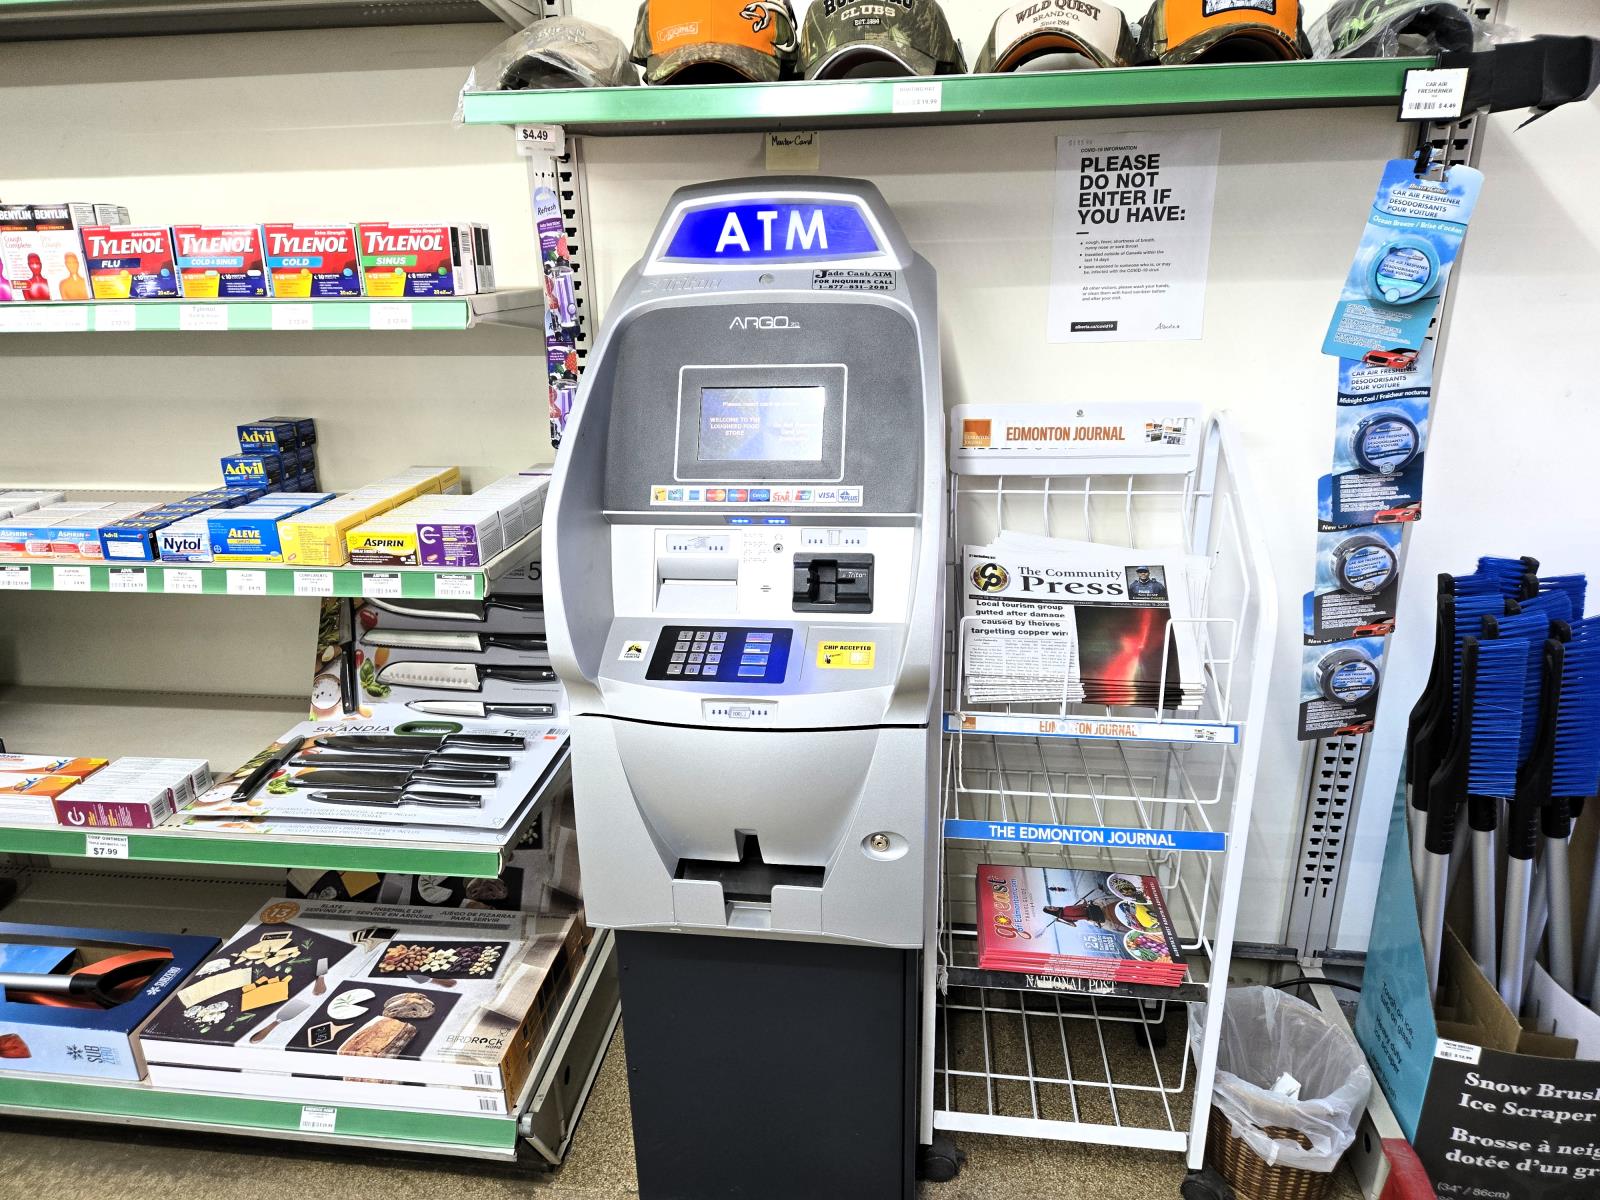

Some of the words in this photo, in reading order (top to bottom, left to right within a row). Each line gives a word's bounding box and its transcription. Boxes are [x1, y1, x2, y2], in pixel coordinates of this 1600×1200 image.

[841, 4, 896, 21] CLUBS
[1016, 0, 1051, 24] WILD
[1055, 0, 1101, 21] QUEST
[1033, 11, 1065, 23] BRAND
[1066, 11, 1080, 21] CO.
[522, 128, 548, 141] $4.49
[1080, 153, 1160, 173] PLEASE
[1079, 174, 1109, 191] DO
[1116, 172, 1159, 189] NOT
[1078, 190, 1147, 208] ENTER
[1153, 188, 1172, 205] IF
[1422, 194, 1461, 206] FRESHENER
[0, 209, 32, 221] BENYLIN
[35, 209, 68, 220] BENYLIN
[538, 203, 557, 216] Refresh
[1078, 208, 1120, 225] YOU
[1126, 205, 1186, 223] HAVE:
[1387, 205, 1407, 214] POUR
[1409, 208, 1438, 219] VOITURE
[715, 209, 829, 252] ATM
[88, 236, 164, 257] TYLENOL
[178, 234, 255, 256] TYLENOL
[270, 233, 348, 255] TYLENOL
[364, 231, 443, 252] TYLENOL
[101, 260, 121, 268] FLU
[191, 258, 210, 266] COLD
[215, 258, 238, 266] SINUS
[282, 257, 310, 266] COLD
[376, 256, 406, 265] SINUS
[815, 270, 845, 279] Jade
[729, 316, 788, 330] ARGO
[1372, 382, 1400, 390] VOITURE
[1339, 394, 1362, 404] Midnight
[240, 430, 276, 443] Advil
[1006, 427, 1068, 441] EDMONTON
[1072, 426, 1126, 441] JOURNAL
[224, 462, 265, 475] Advil
[228, 527, 261, 539] ALEVE
[163, 538, 201, 552] Nytol
[363, 538, 404, 547] ASPIRIN
[528, 561, 542, 581] 5
[1018, 566, 1041, 576] The
[1045, 568, 1122, 580] Community
[1021, 575, 1124, 596] Press
[1001, 601, 1035, 609] tourism
[1015, 619, 1026, 627] by
[971, 627, 1016, 635] targetting
[1018, 628, 1050, 636] copper
[313, 725, 391, 733] SKANDIA
[989, 825, 1016, 838] THE
[1019, 826, 1104, 843] EDMONTON
[1107, 831, 1176, 847] JOURNAL
[93, 847, 118, 856] $7.99
[988, 877, 1012, 912] east
[271, 907, 291, 918] 13
[993, 914, 1032, 940] go
[1026, 974, 1085, 991] NATIONAL
[1088, 978, 1117, 994] POST
[84, 1044, 103, 1063] SUB
[1464, 1071, 1532, 1096] Snow
[1458, 1092, 1497, 1113] Ice
[1502, 1101, 1597, 1124] Scraper
[1450, 1126, 1532, 1151] Brosse
[1537, 1139, 1551, 1153] à
[1445, 1148, 1511, 1169] dotée
[1515, 1158, 1569, 1175] d'un
[1472, 1187, 1511, 1200] 86cm)
